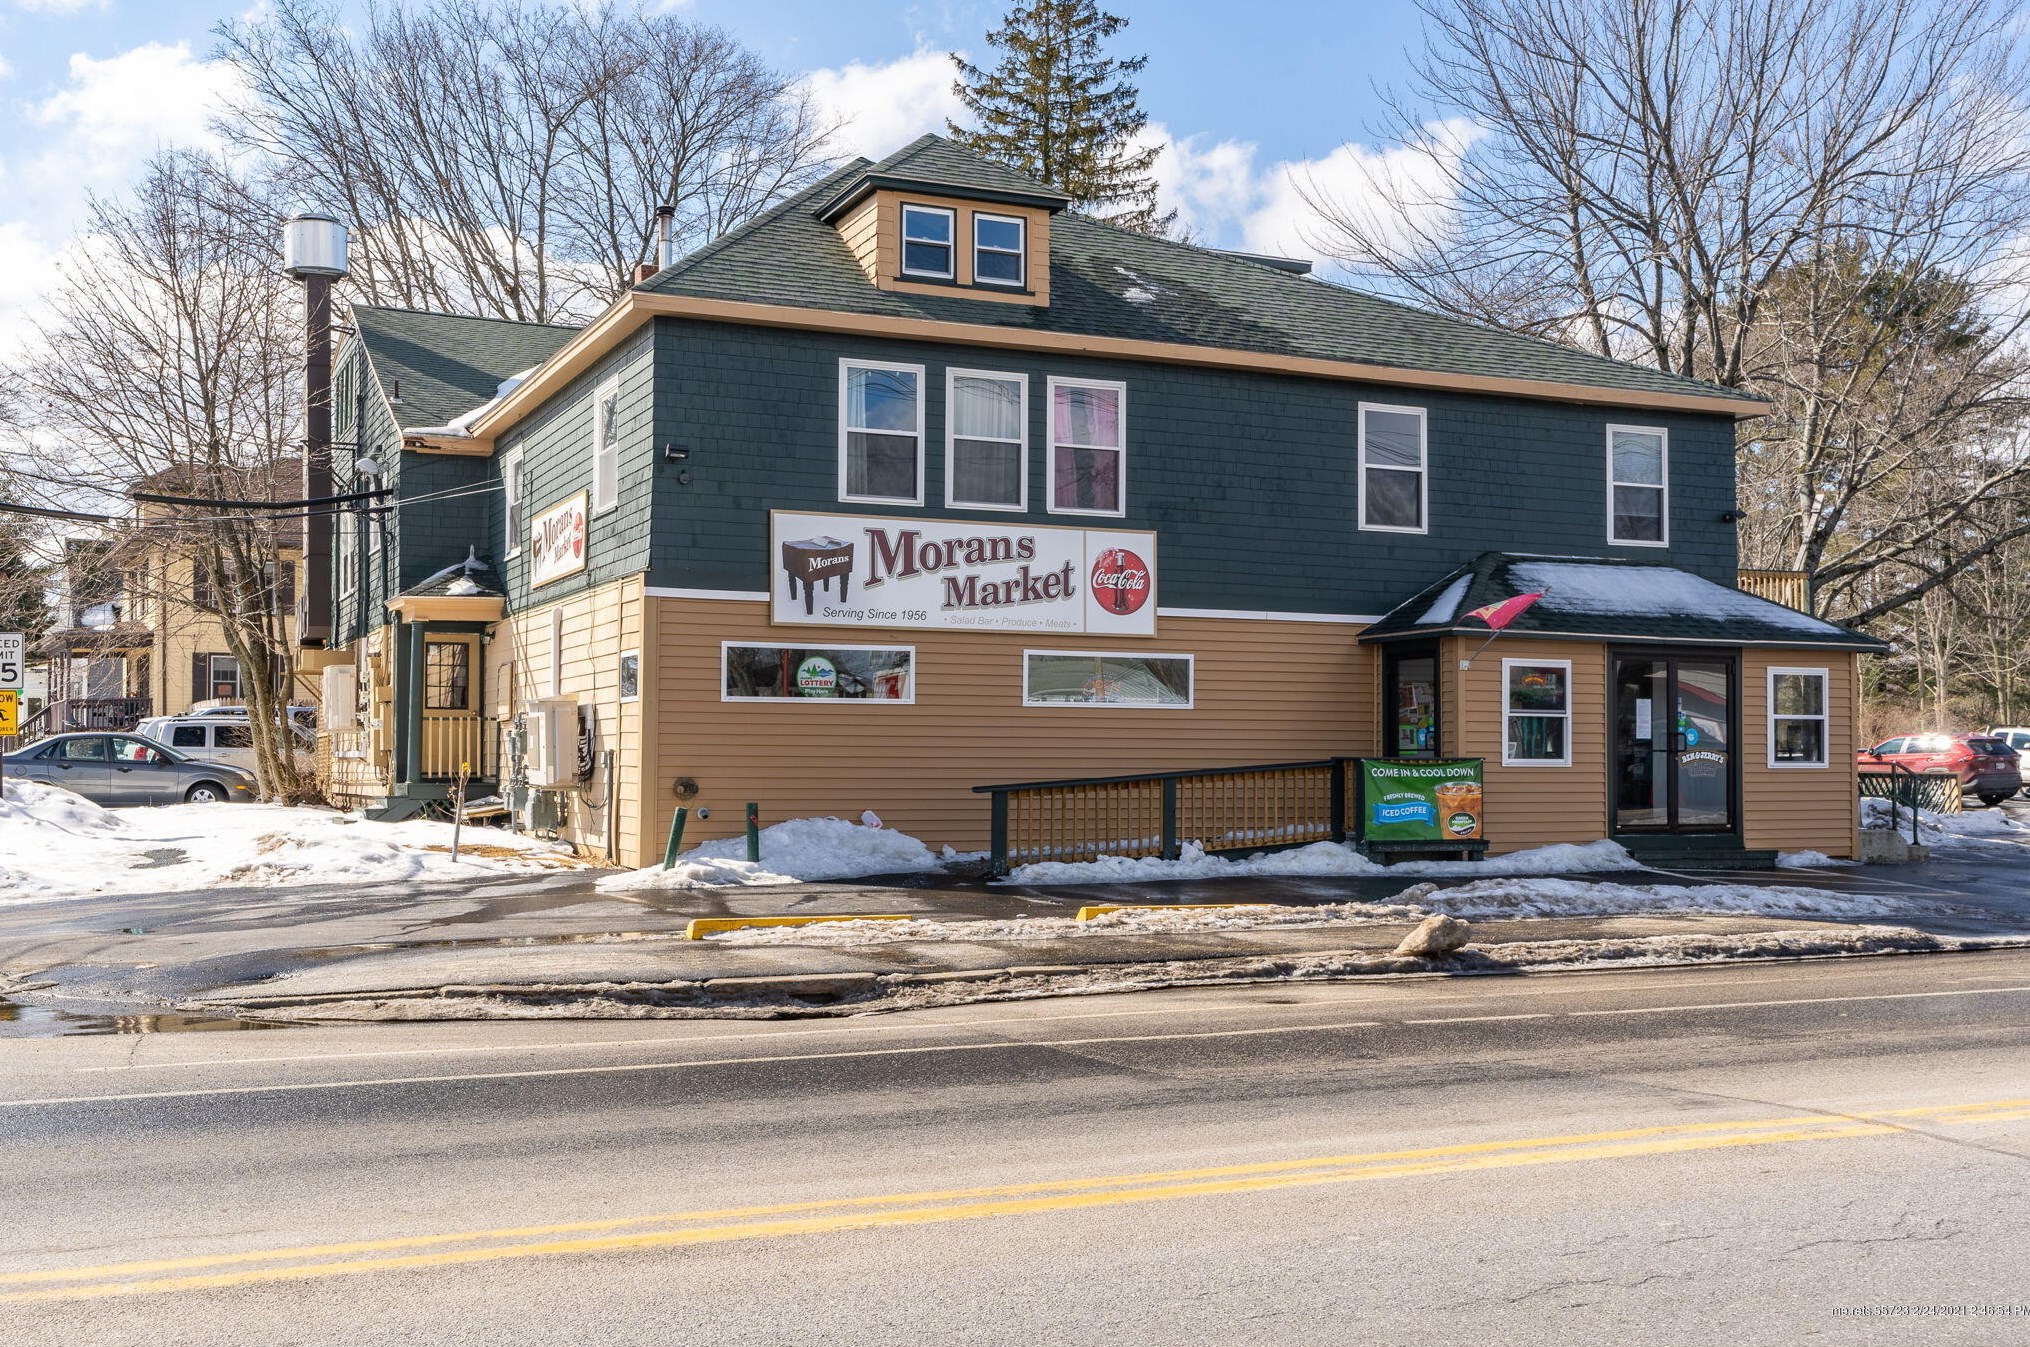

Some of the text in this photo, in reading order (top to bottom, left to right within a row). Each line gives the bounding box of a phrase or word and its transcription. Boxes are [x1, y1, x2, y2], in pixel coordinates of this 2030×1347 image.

[808, 554, 849, 572] Morans
[863, 527, 1036, 589] Morans
[941, 559, 1076, 611] Market
[823, 607, 927, 621] Serving Since 1956
[950, 615, 1071, 629] Salad Bar Produce Meats
[1371, 768, 1474, 777] COME IN & COOL DOWN
[1383, 793, 1404, 801] FRESHLY
[1382, 806, 1427, 817] ICED COFFEE
